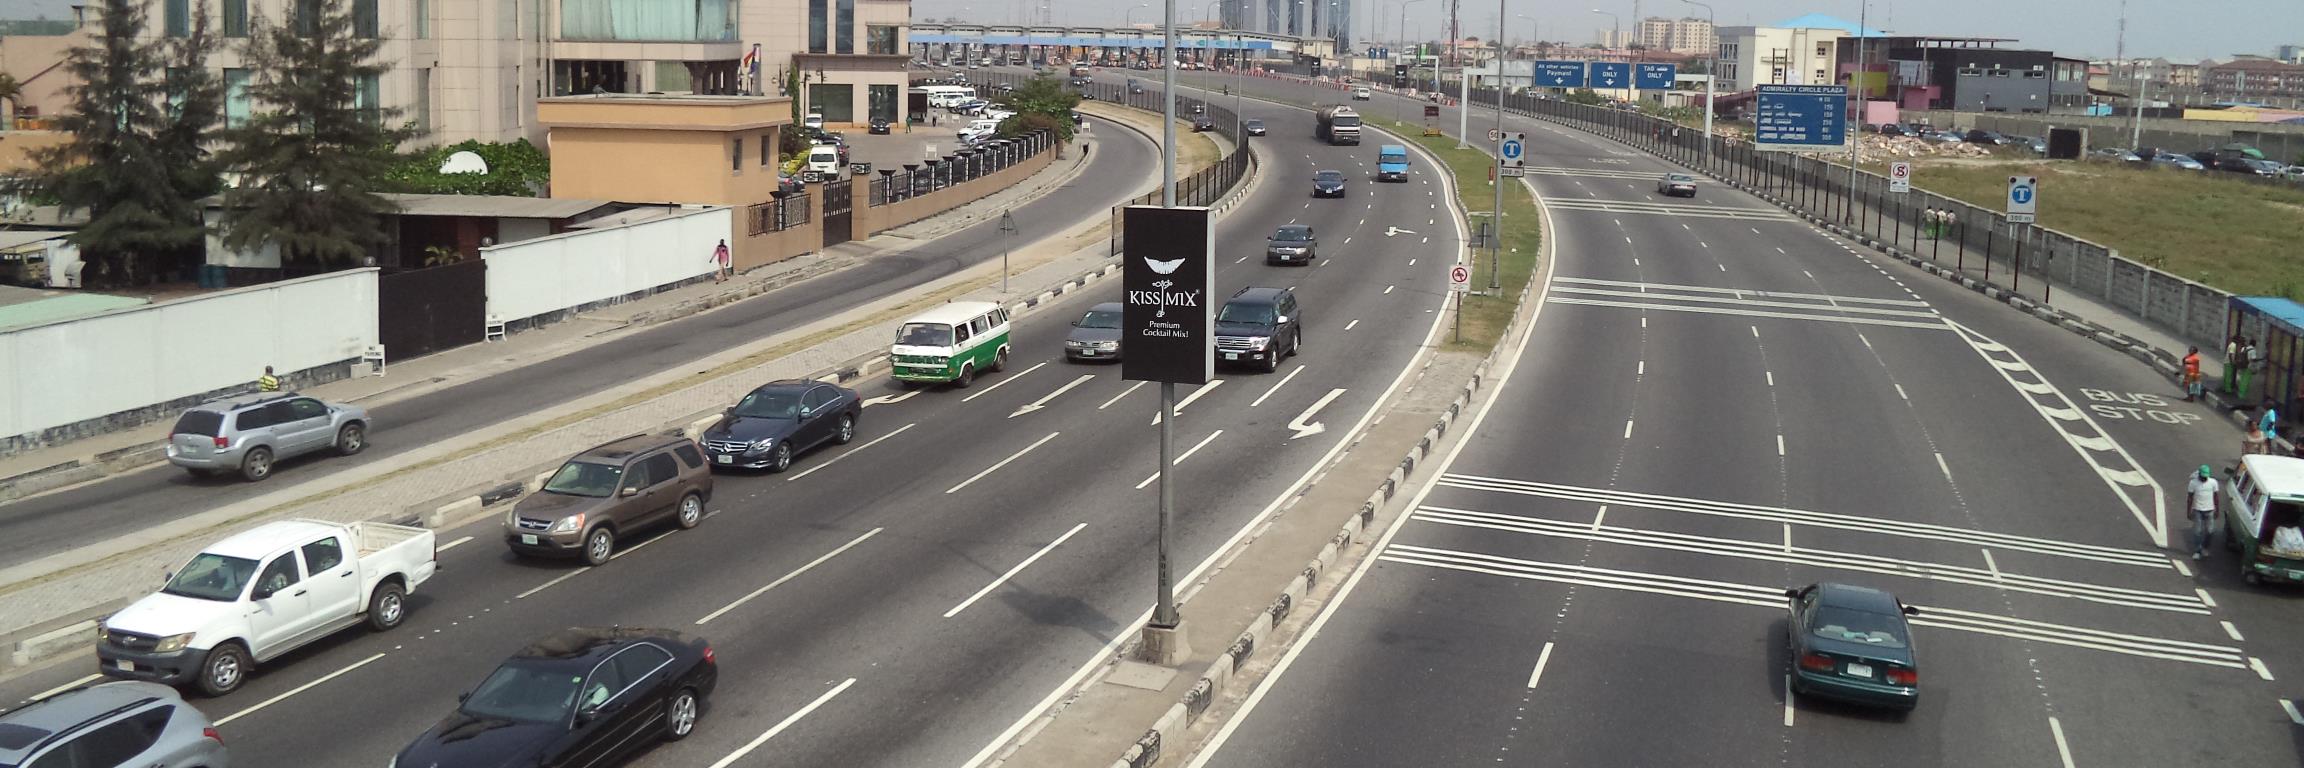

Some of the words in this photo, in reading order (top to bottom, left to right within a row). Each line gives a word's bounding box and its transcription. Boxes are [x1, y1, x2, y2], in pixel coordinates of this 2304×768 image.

[1130, 291, 1161, 305] KISS
[1150, 321, 1180, 329] Premium
[1143, 329, 1170, 337] Cocktail
[1172, 330, 1189, 338] Mix!
[2080, 388, 2168, 406] BUS
[2089, 404, 2202, 425] STOP
